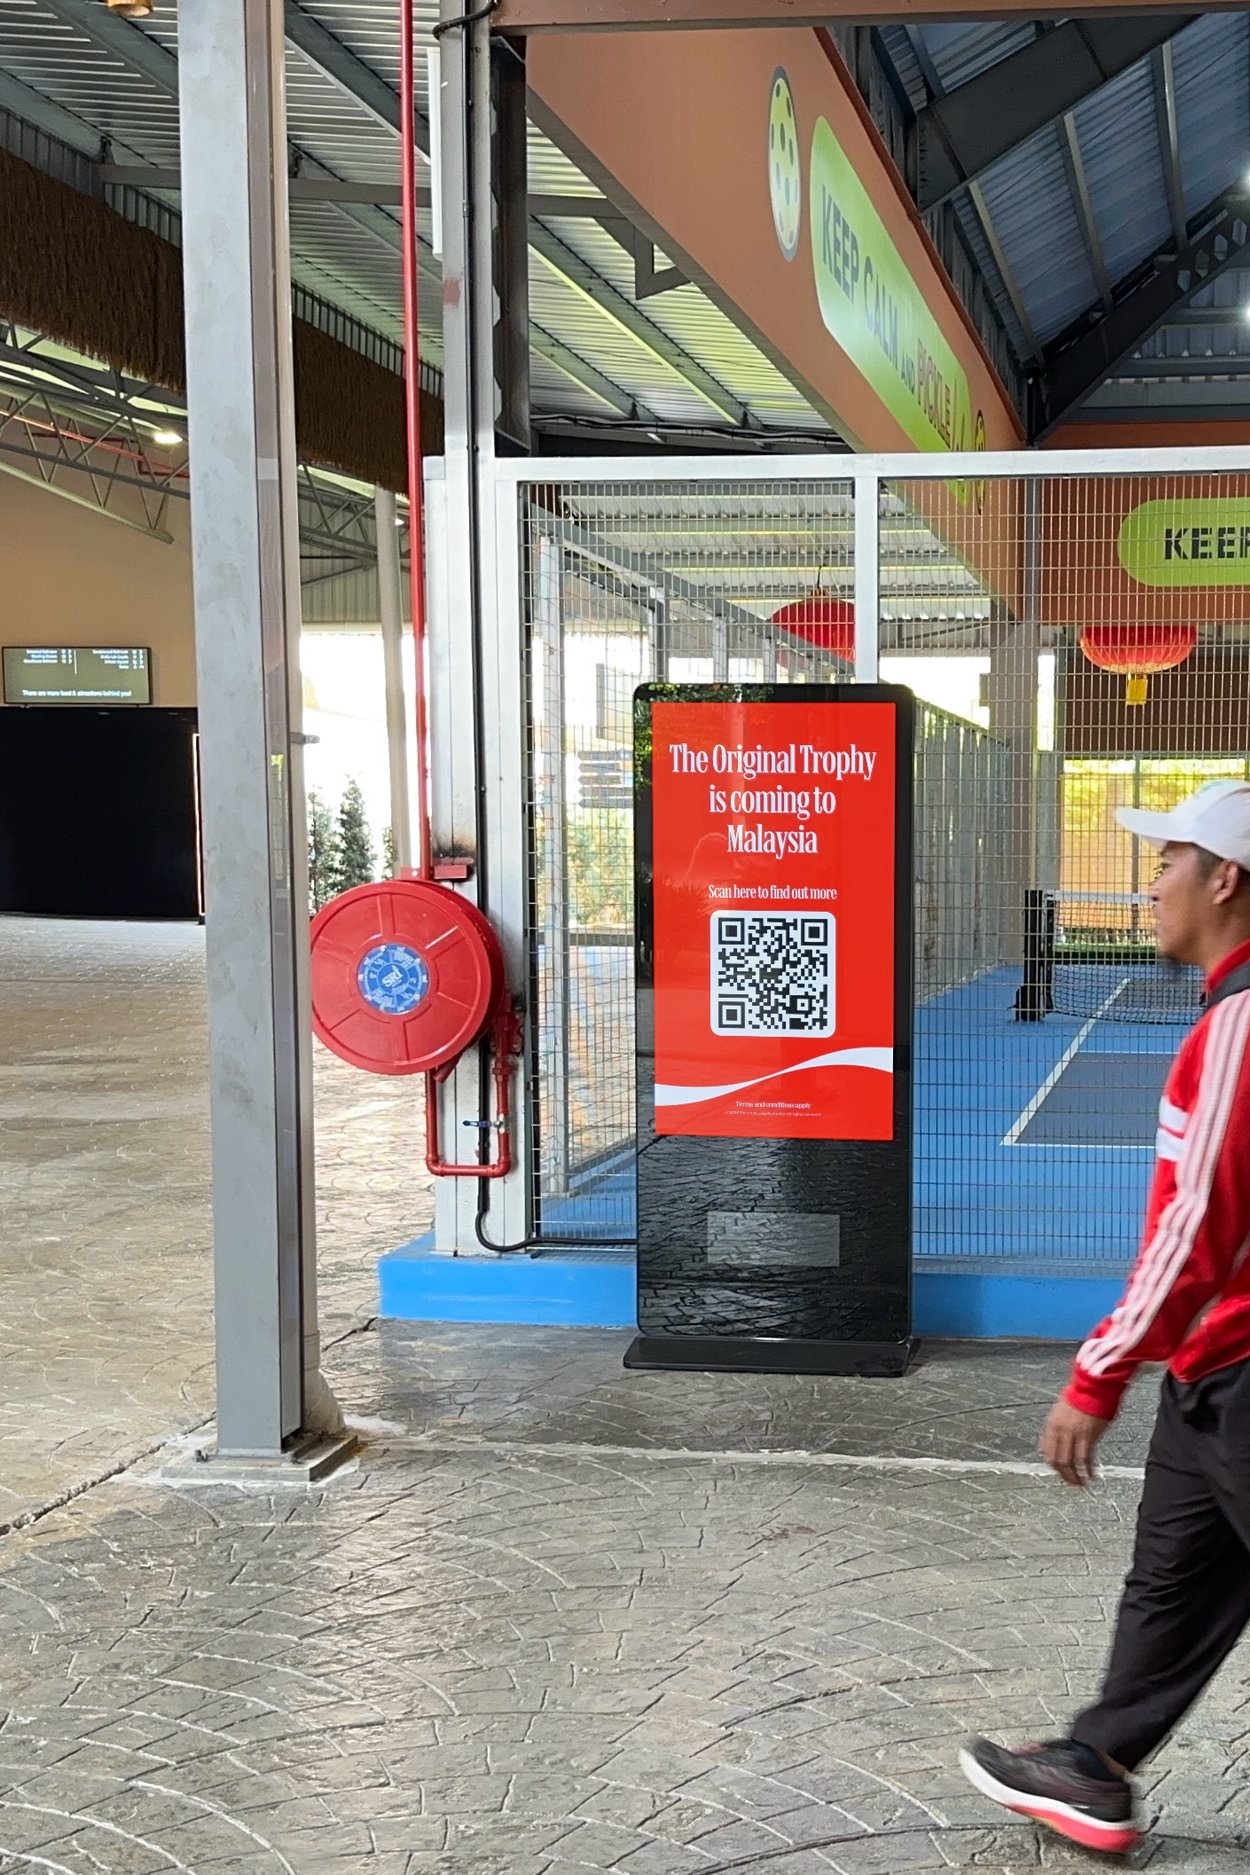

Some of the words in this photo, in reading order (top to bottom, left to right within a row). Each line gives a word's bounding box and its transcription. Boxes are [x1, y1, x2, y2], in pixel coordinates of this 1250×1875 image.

[821, 184, 860, 304] KEEP
[864, 255, 899, 372] CALM
[901, 350, 916, 395] AND
[917, 336, 951, 449] PICKLE
[669, 743, 709, 773] The
[712, 743, 796, 780] Original
[800, 743, 877, 781] Trophy
[709, 784, 727, 813] is
[730, 784, 811, 821] coming
[813, 786, 836, 814] to
[727, 823, 818, 860] Malaysia
[708, 884, 732, 899] Scan
[733, 883, 757, 899] here
[757, 885, 769, 899] to
[770, 884, 791, 899] find
[791, 886, 809, 899] out
[810, 888, 837, 900] more
[765, 1101, 795, 1109] conditions
[795, 1102, 811, 1110] apply
